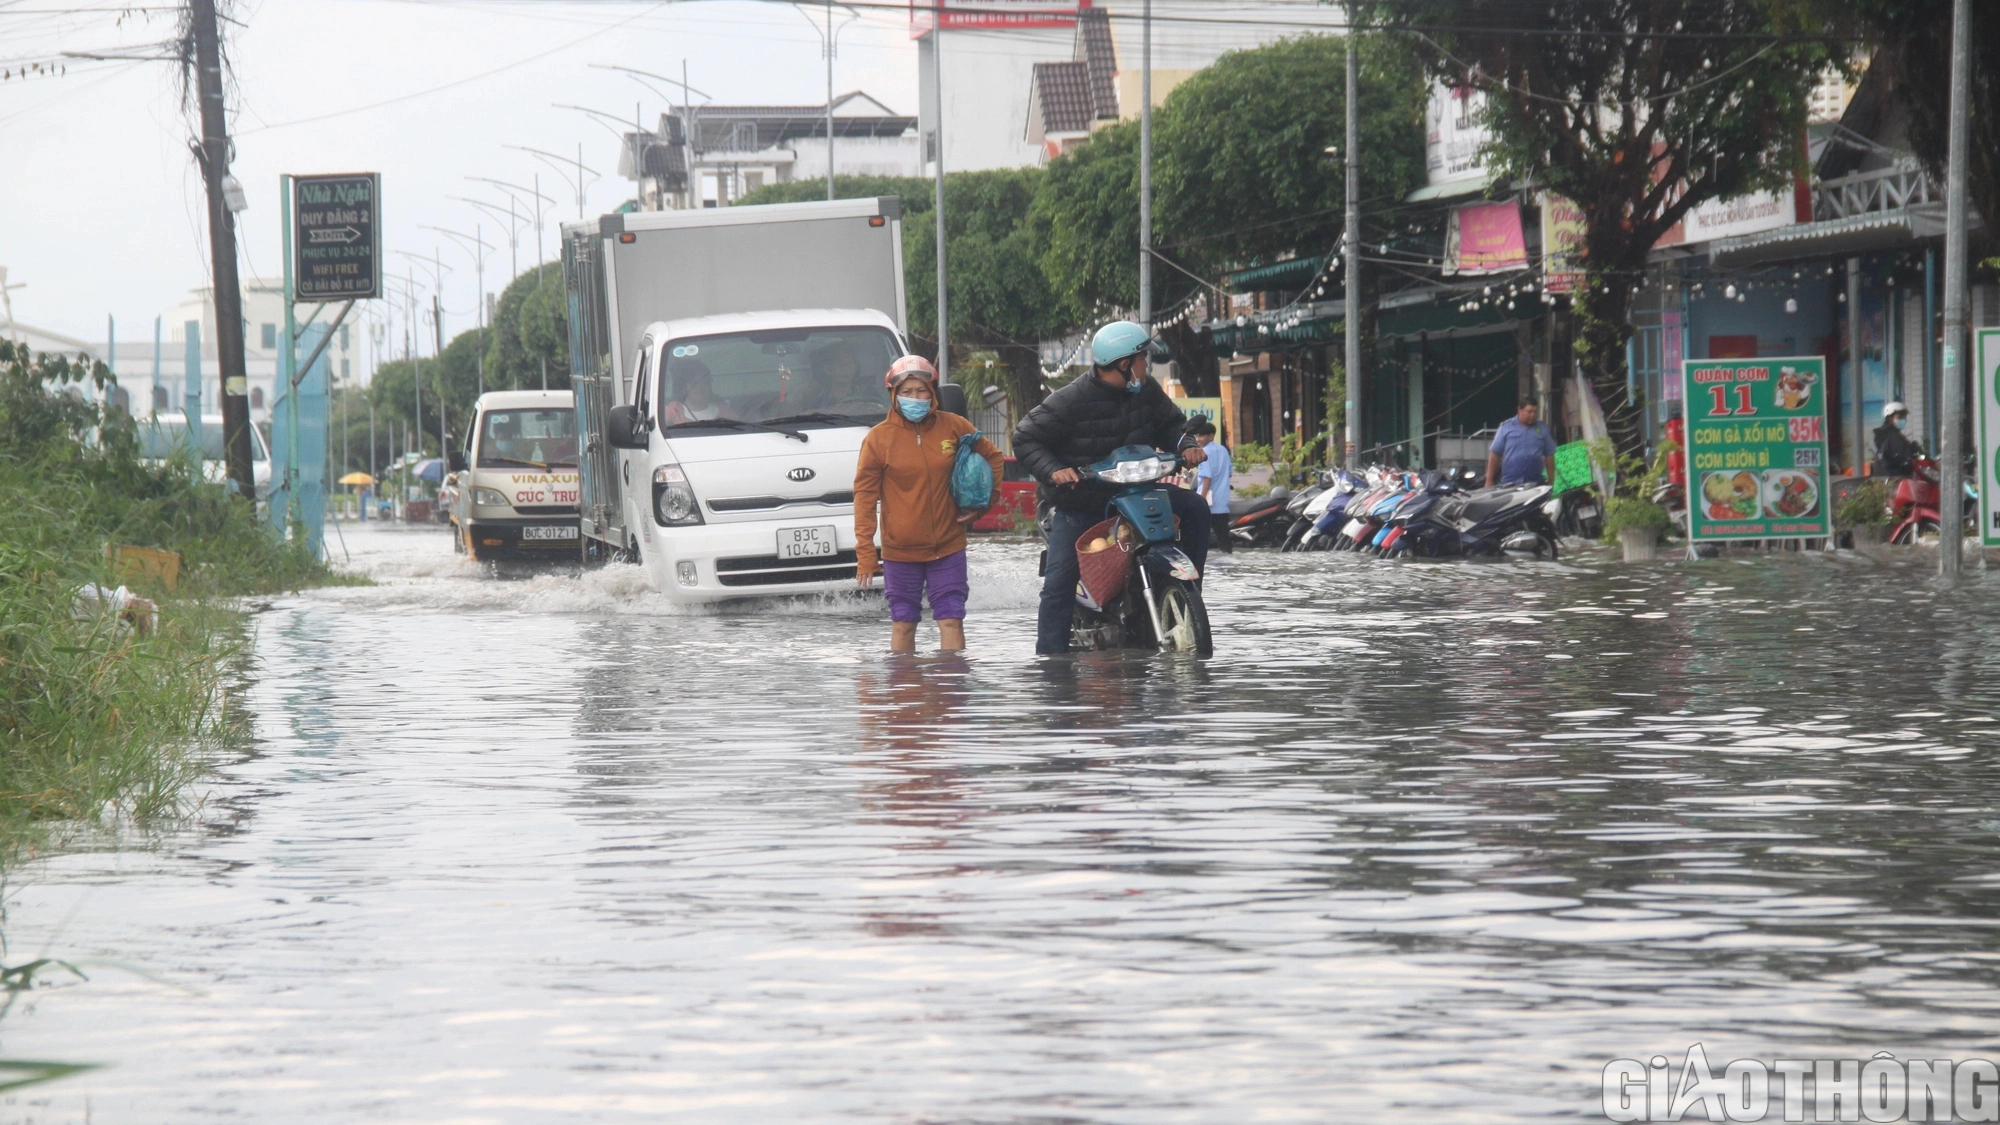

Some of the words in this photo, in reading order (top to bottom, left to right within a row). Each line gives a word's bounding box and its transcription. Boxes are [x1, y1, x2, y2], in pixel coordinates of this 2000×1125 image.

[300, 185, 332, 204] Nhà
[334, 182, 371, 206] Nghỉ
[301, 212, 324, 226] DUY
[360, 210, 369, 223] 2
[302, 247, 326, 260] PHỤC
[328, 247, 340, 259] VỤ
[313, 264, 333, 275] WIFI
[335, 263, 359, 274] FREE
[343, 280, 354, 290] XE
[1694, 366, 1733, 383] QUÁN
[1736, 367, 1769, 382] CƠM
[1709, 384, 1757, 416] 11
[1695, 428, 1722, 444] CƠM
[1724, 424, 1740, 443] GÀ
[1789, 417, 1823, 442] 35K
[1695, 453, 1723, 469] CƠM
[1759, 447, 1770, 466] BÌ
[1795, 449, 1820, 466] 25K
[790, 469, 811, 479] KIA
[516, 487, 544, 502] CÚC
[552, 490, 579, 502] TRƯ
[793, 528, 820, 542] 83C
[786, 541, 831, 557] 104.78
